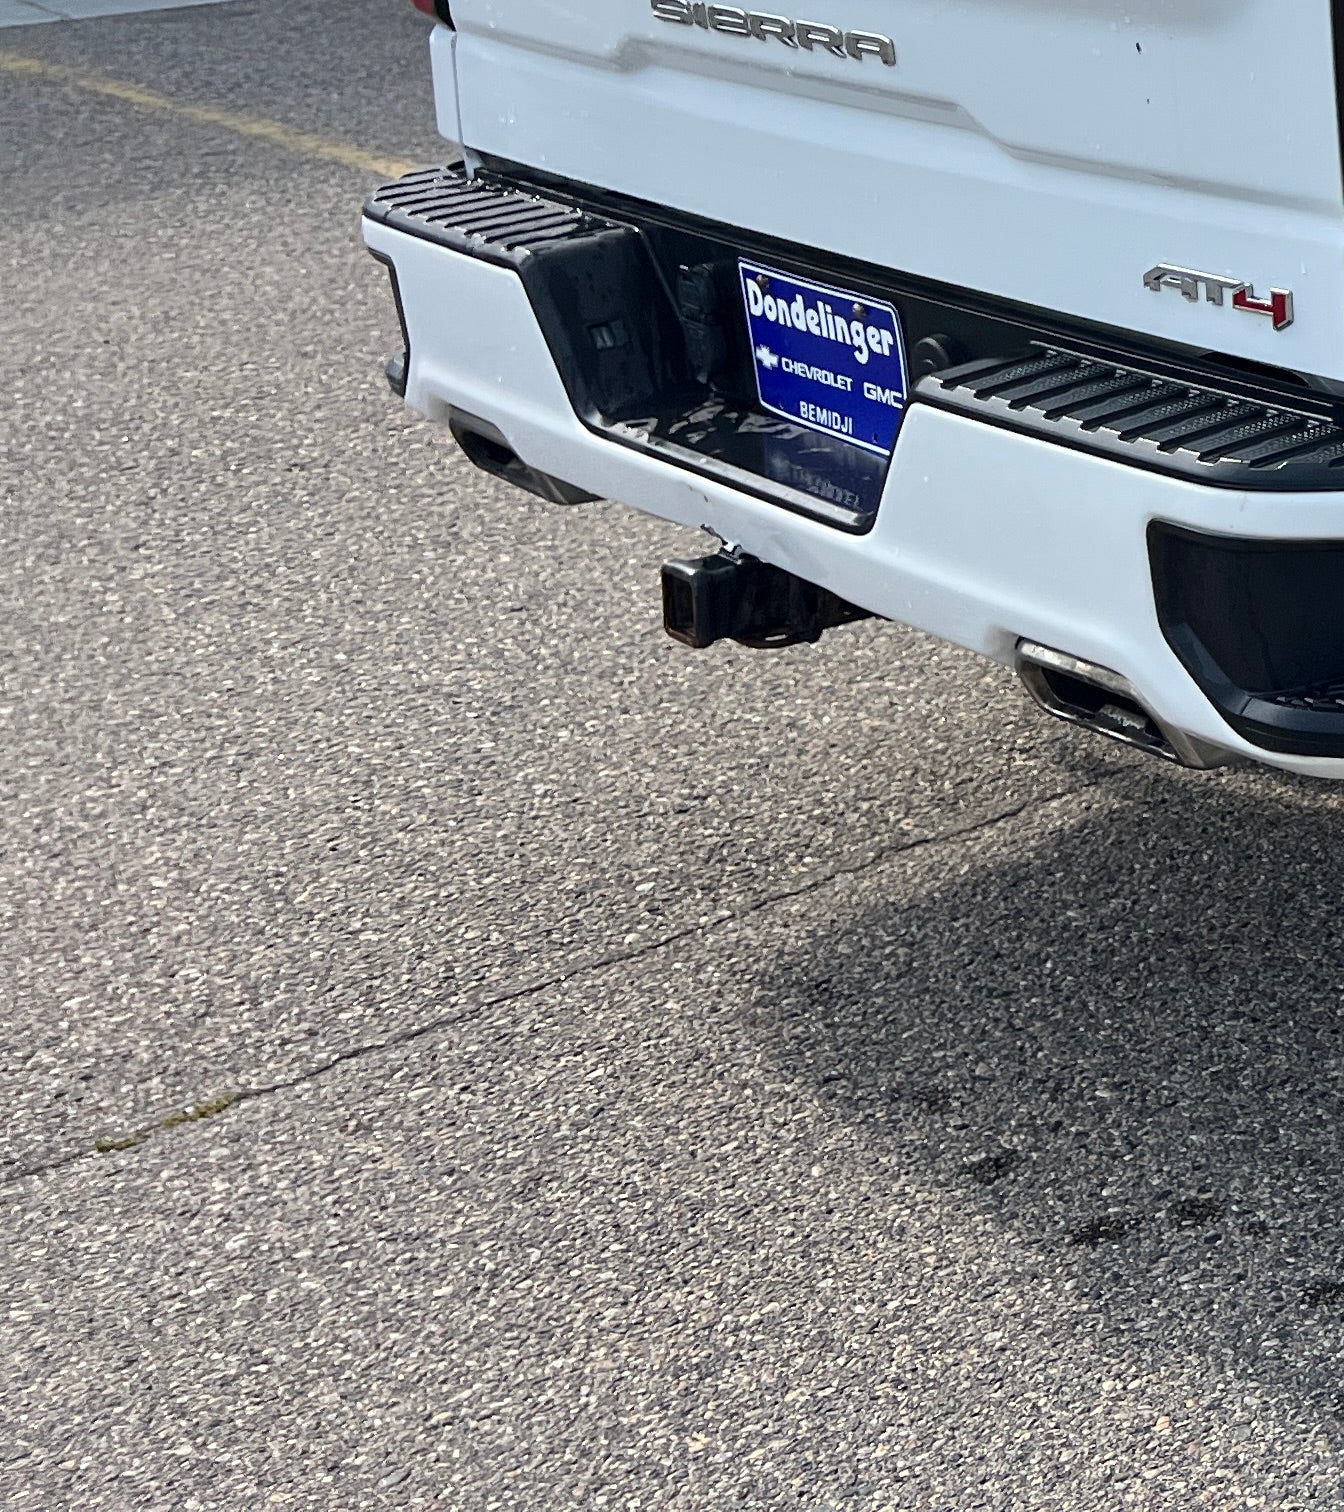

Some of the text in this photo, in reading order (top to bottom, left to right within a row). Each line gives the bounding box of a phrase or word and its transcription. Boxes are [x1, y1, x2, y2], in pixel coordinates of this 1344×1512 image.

[746, 277, 894, 365] Dondelinger
[1143, 263, 1294, 331] AT4
[781, 357, 903, 409] CHEVROLET GMC
[799, 400, 853, 435] BEMIDJI
